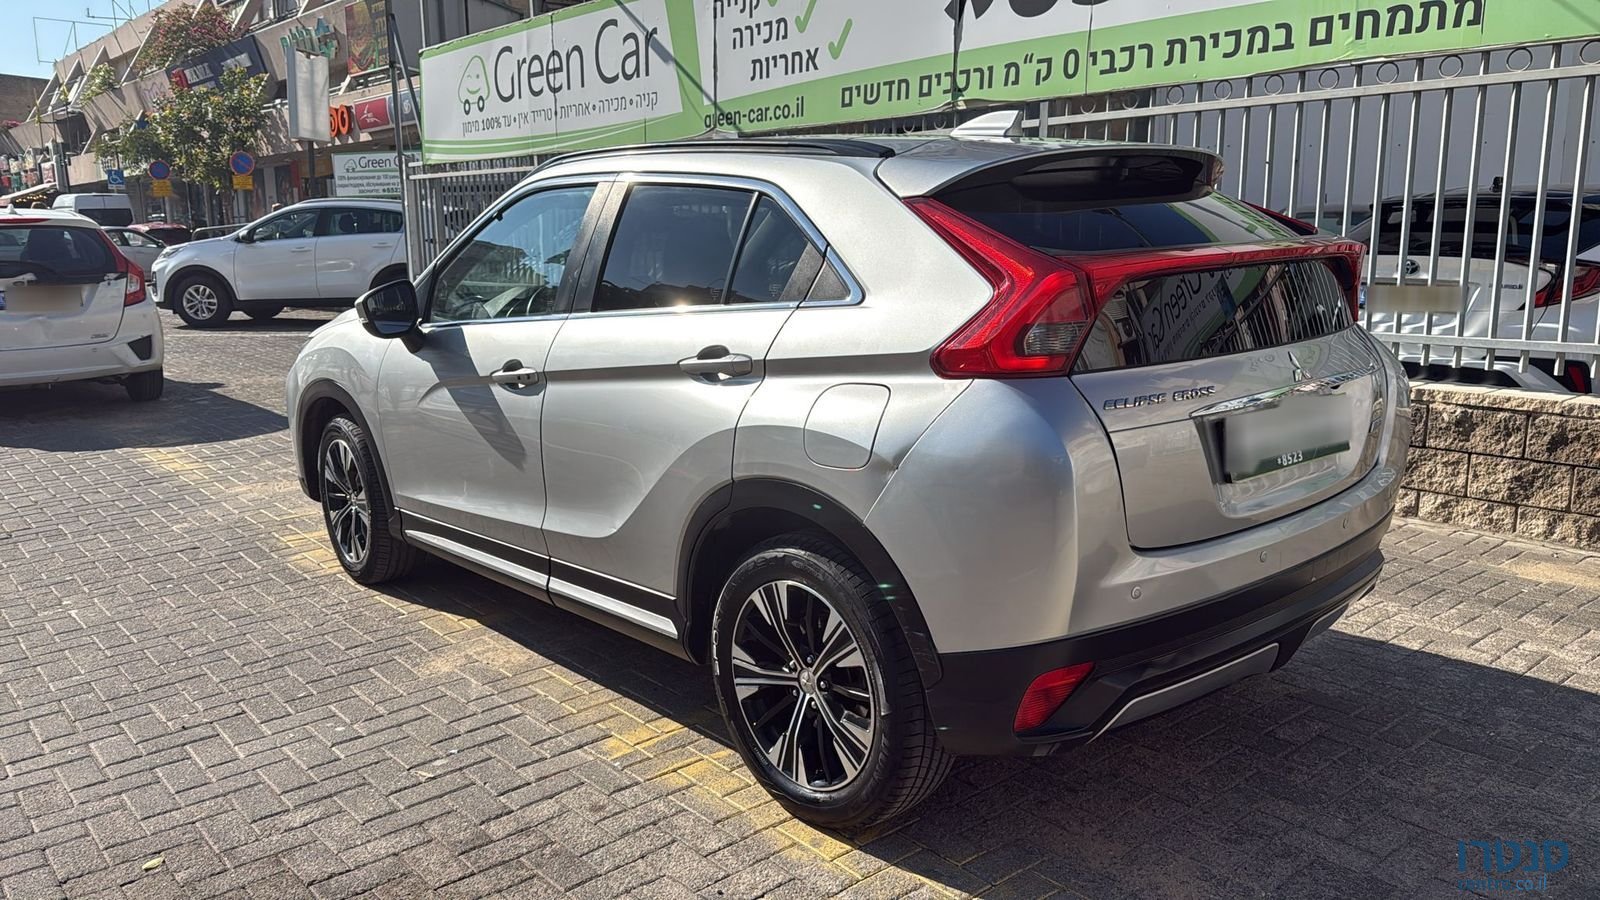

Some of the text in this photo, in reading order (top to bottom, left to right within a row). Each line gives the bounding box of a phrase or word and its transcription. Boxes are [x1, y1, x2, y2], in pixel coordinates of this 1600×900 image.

[732, 17, 788, 50] מכירה
[1308, 0, 1483, 47] מתמחים
[1164, 23, 1295, 67] במכירת
[494, 19, 658, 103] Green Car
[750, 47, 819, 81] אחריות
[1062, 48, 1081, 80] 0
[1088, 43, 1153, 75] רכבי
[840, 78, 910, 108] חדשים
[918, 65, 994, 98] ורכבים
[560, 102, 591, 119] אחריות
[599, 96, 626, 114] מכירה
[636, 91, 658, 111] קניה
[462, 120, 480, 138] מימון
[481, 117, 502, 132] 100%
[502, 114, 512, 128] עד
[518, 112, 529, 129] אין
[358, 156, 392, 169] Green
[1104, 386, 1216, 410] ECLIPSE CROSS
